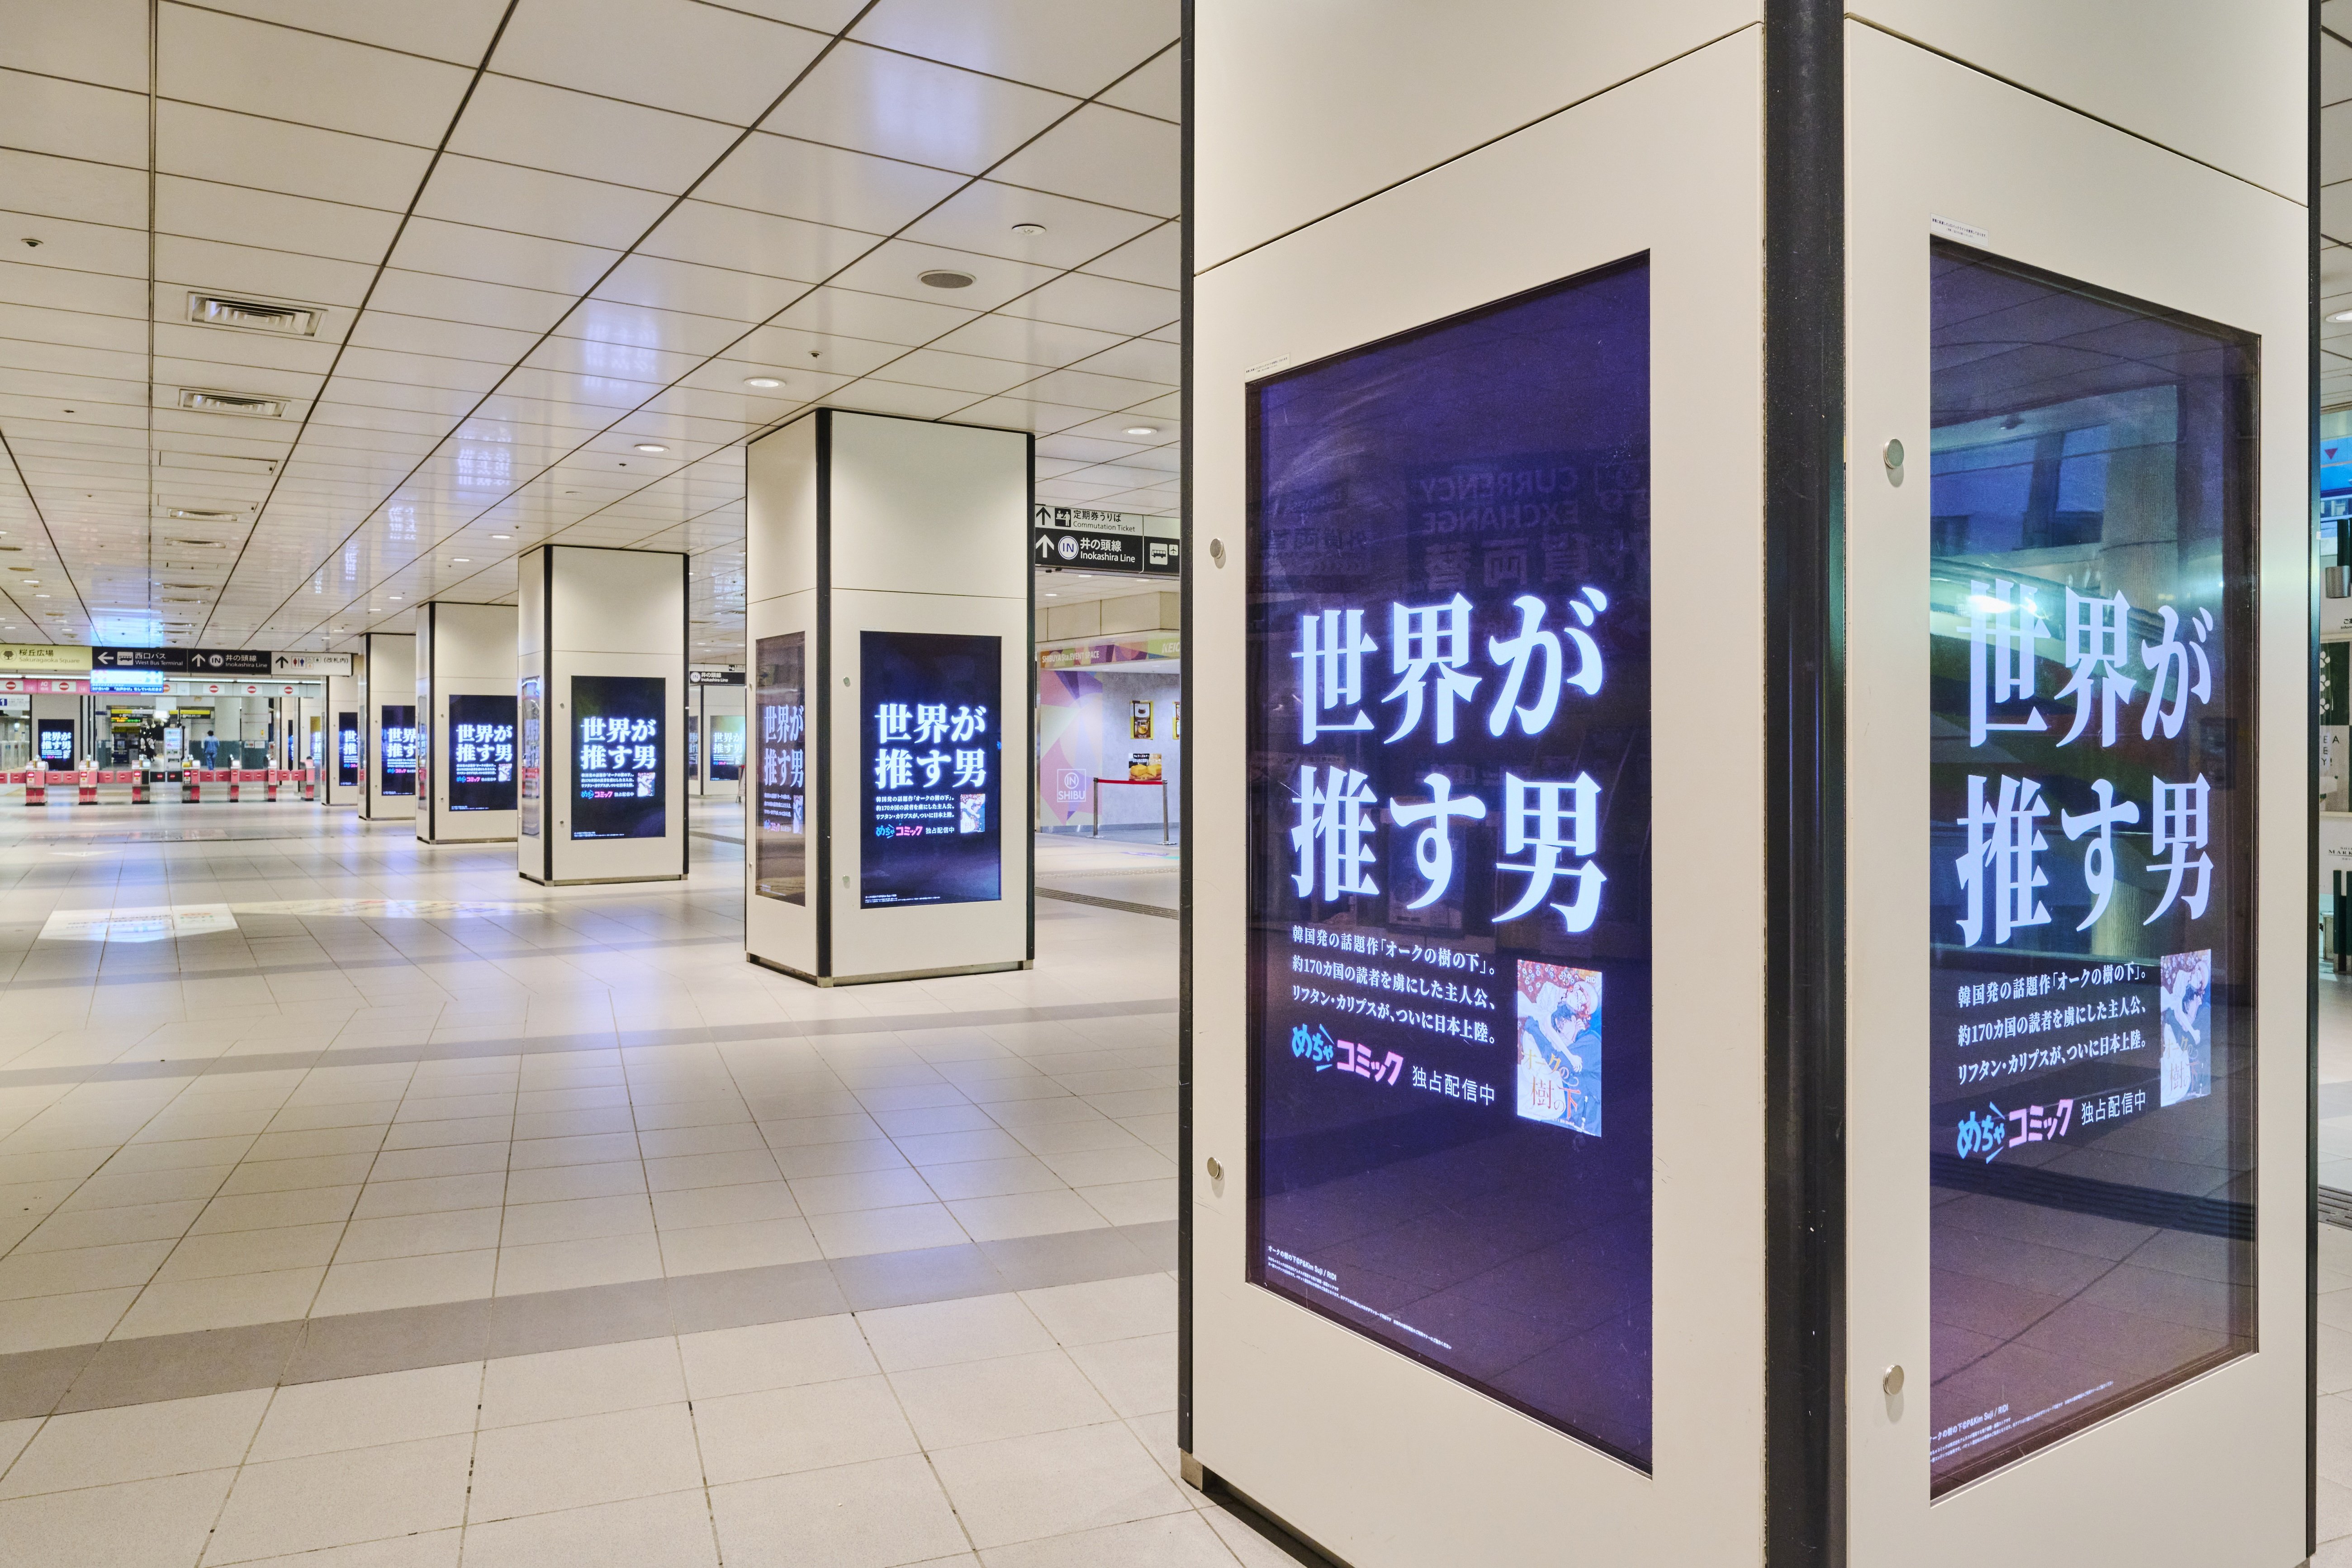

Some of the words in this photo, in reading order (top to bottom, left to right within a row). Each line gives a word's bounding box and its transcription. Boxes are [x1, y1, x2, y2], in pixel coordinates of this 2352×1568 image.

[1073, 510, 1121, 522] 定期券うりば
[1073, 521, 1116, 531] Commutation
[1117, 524, 1135, 532] Ticket
[1062, 543, 1075, 553] IN
[1080, 537, 1122, 552] 井の頭線
[1081, 550, 1119, 562] Inokashira
[1120, 554, 1135, 563] Line
[1042, 654, 1061, 663] SHIBUYA
[1085, 650, 1100, 659] SPACE
[1291, 587, 1607, 744] 世界が
[1956, 578, 2213, 748] 世界が
[42, 731, 71, 741] 世界が
[456, 724, 512, 743] 世界が
[581, 717, 656, 743] 世界が
[764, 704, 804, 744] 世界が
[875, 703, 986, 744] 世界が
[41, 740, 71, 750] 推す男
[713, 732, 743, 743] 世界が
[713, 743, 743, 753] 推す男
[456, 744, 512, 762] 推す男
[581, 745, 656, 769] 推す男
[764, 748, 804, 788] 推す男
[875, 748, 986, 789] 推す男
[1067, 776, 1076, 785] IN
[1058, 791, 1085, 800] SHIBU
[876, 824, 923, 838] めちゃコミック
[1291, 765, 1607, 933] 推す男
[1956, 772, 2214, 948] 推す男
[1293, 925, 1494, 975] 韓国発の話題作「オークの樹の下」。
[1293, 954, 1494, 1010] 約170カ国の読者を虜にした主人公、
[1958, 962, 2145, 1008] 韓国発の話題作「オークの樹の下」。
[1293, 985, 1494, 1044] リフタン・カリプスが、ついに日本上陸。
[1958, 995, 2146, 1047] 約170カ国の読者を虜にした主人公、
[1292, 1023, 1404, 1086] めちゃコミック
[1413, 1066, 1494, 1106] 独占配信中
[1958, 1029, 2145, 1085] リフタン・カリプスが、ついに日本上陸。
[1957, 1099, 2074, 1163] めちゃコミック
[2082, 1089, 2145, 1126] 独占配信中
